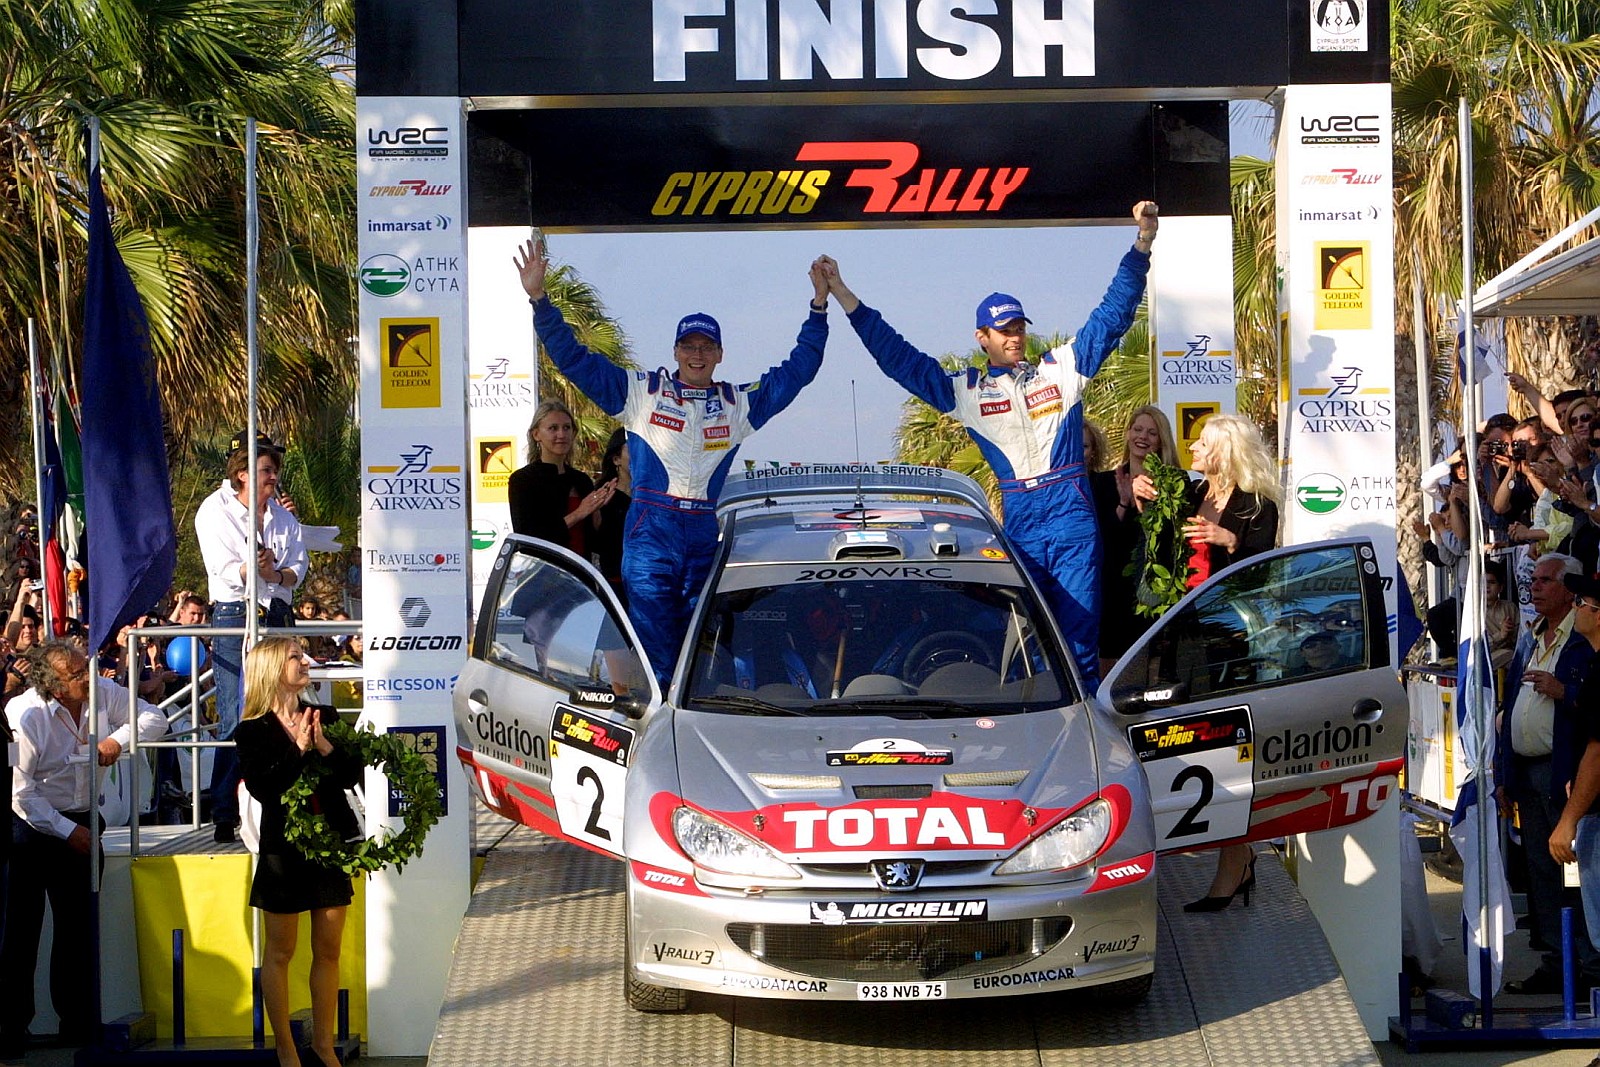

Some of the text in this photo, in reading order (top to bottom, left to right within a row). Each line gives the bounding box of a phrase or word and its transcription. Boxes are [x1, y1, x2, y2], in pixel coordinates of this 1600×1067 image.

[653, 0, 1096, 82] FINISH
[1301, 115, 1380, 132] WRC
[368, 127, 448, 145] WRC
[651, 142, 1030, 216] CYPRUS RALLY
[1331, 169, 1383, 185] RALLY
[369, 179, 452, 197] CYPRUS RALLY
[1299, 209, 1363, 221] inmarsat
[368, 219, 432, 233] inmarsat
[414, 257, 459, 272] ATHK
[414, 277, 460, 293] CYTA
[1325, 292, 1361, 300] GOLDEN
[1323, 301, 1363, 309] TELECOM
[392, 369, 428, 378] GOLDEN
[1162, 360, 1232, 373] CYPRUS
[390, 379, 431, 388] TELECOM
[1163, 374, 1232, 385] AIRWAYS
[470, 383, 532, 396] YPRUS
[982, 404, 1009, 413] VALTRA
[1299, 400, 1391, 418] CYPRUS
[654, 415, 680, 428] VALTRA
[1301, 419, 1392, 433] AIRWAYS
[756, 465, 943, 479] PEUGEOT FINANCIAL SERVICES
[368, 477, 461, 495] CYPRUS
[1350, 476, 1394, 489] ATHK
[369, 497, 461, 511] AIRWAYS
[1350, 496, 1395, 510] CYTA
[369, 635, 463, 651] LOGICOM
[366, 678, 446, 691] ERICSSON
[580, 691, 615, 703] NIKKO
[476, 712, 547, 762] clarion
[588, 724, 620, 752] RALLY
[1158, 721, 1234, 748] CYPRUS RALLY
[883, 740, 897, 750] 2
[1262, 720, 1372, 765] clarion
[551, 743, 558, 757] A
[1239, 746, 1250, 760] A
[889, 753, 946, 764] RALLY
[576, 766, 612, 842] 2
[1165, 765, 1214, 840] 2
[783, 806, 1006, 849] TOTAL
[644, 870, 686, 887] TOTAL
[1101, 863, 1146, 880] TOTAL
[850, 901, 986, 918] MICHELIN
[973, 967, 1076, 990] EURODATACAR
[861, 984, 943, 998] 938 NVB 75
